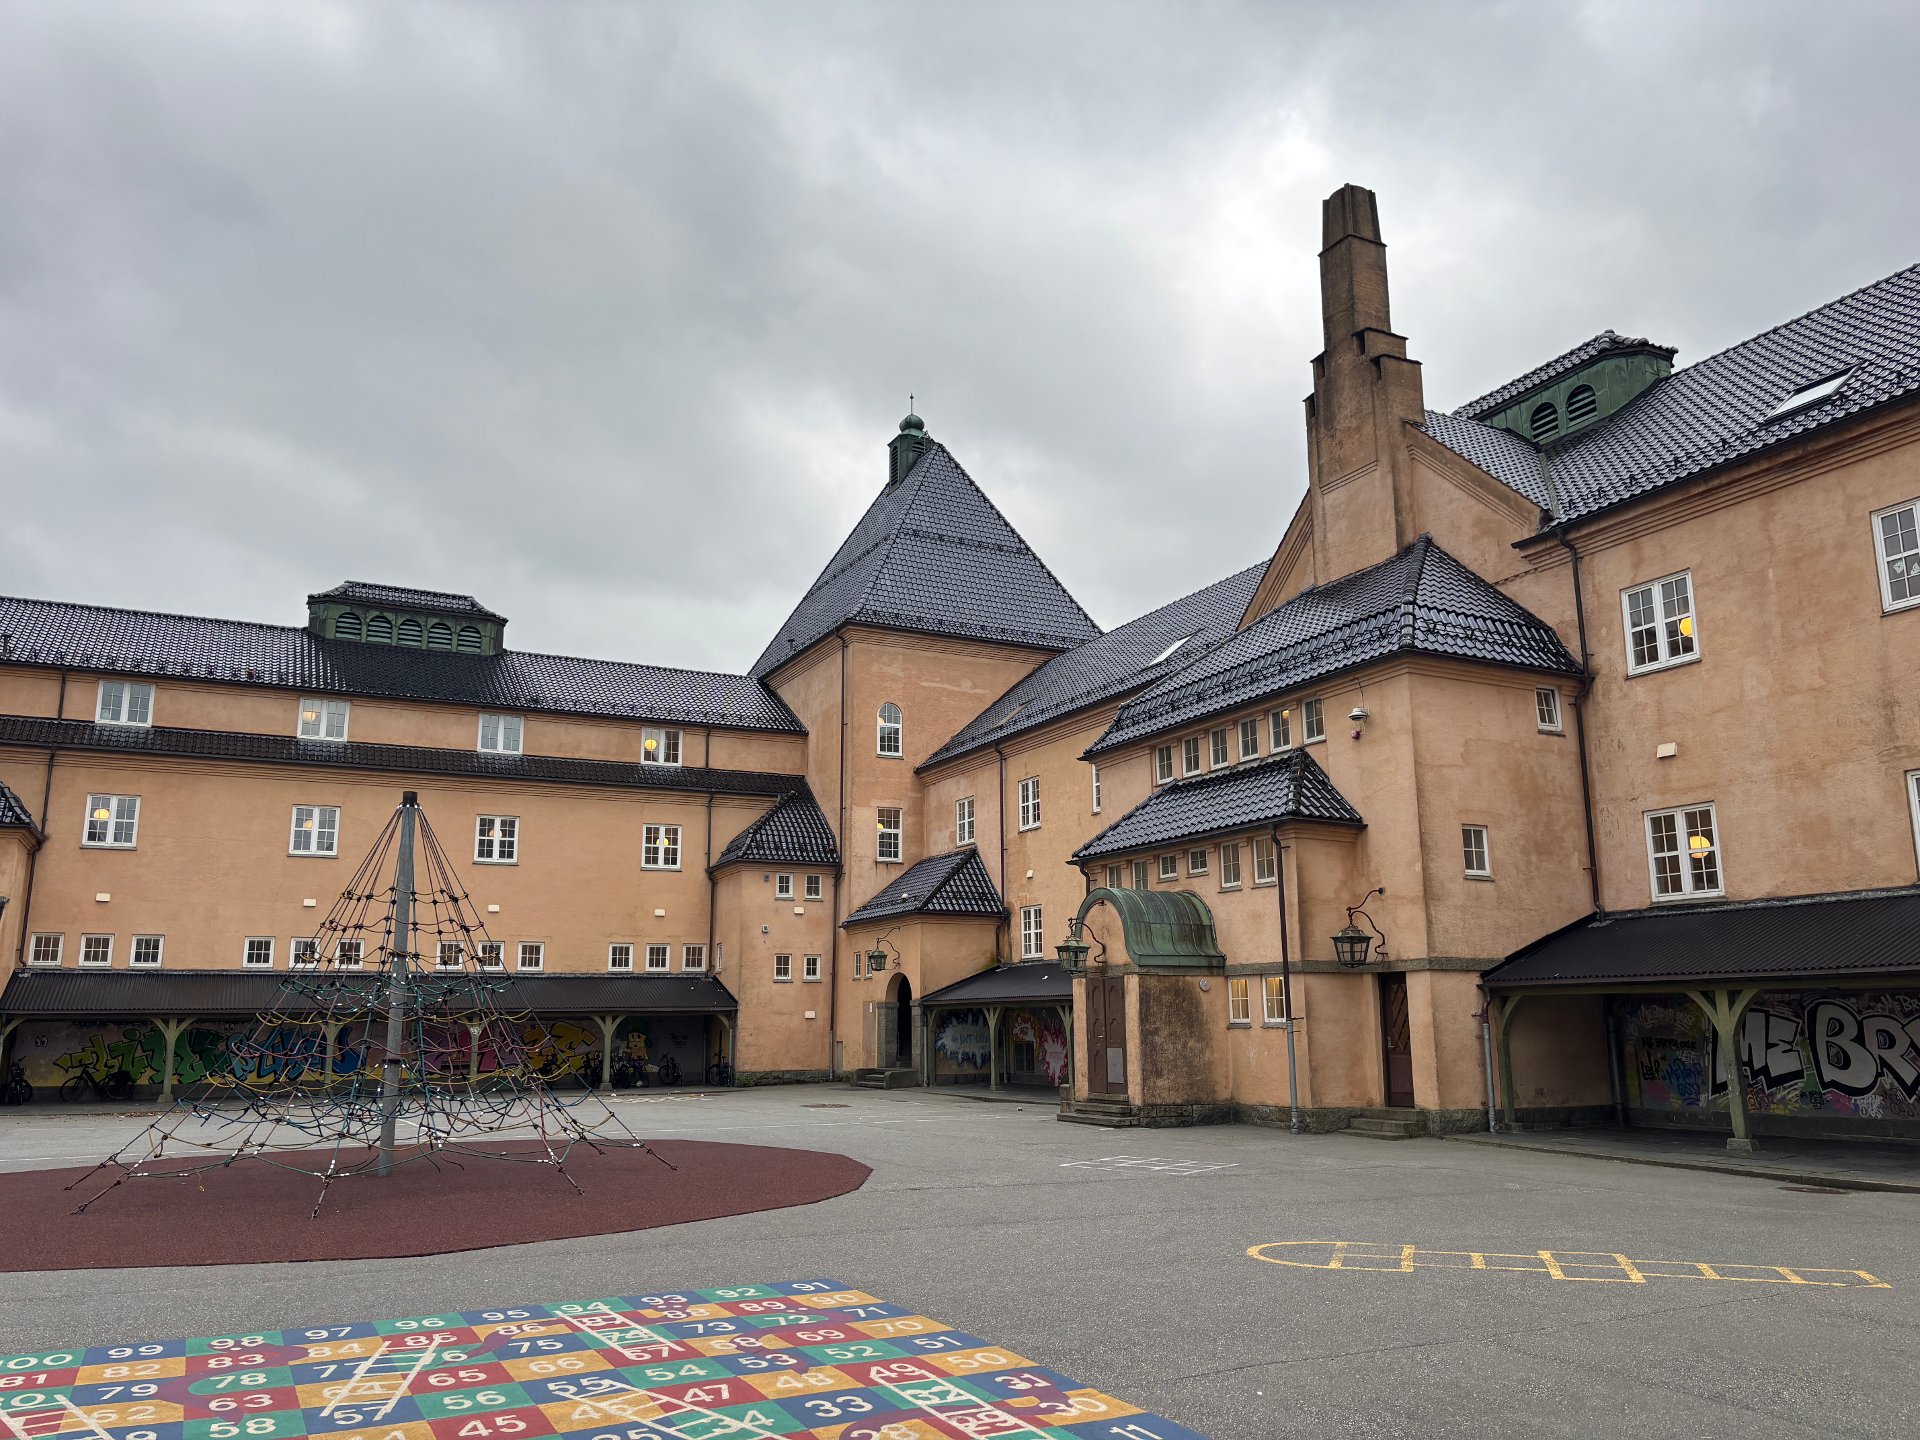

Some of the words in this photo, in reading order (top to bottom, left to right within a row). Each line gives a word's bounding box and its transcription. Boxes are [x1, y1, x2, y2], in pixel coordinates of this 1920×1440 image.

[1806, 1000, 1920, 1103] BR
[0, 1353, 74, 1370] 00
[107, 1345, 164, 1359] 99
[211, 1335, 265, 1350] 98
[304, 1327, 352, 1340] 97
[395, 1318, 445, 1330] 96
[481, 1310, 530, 1321] 95
[560, 1301, 612, 1313] 94
[641, 1294, 688, 1305] 93
[716, 1287, 763, 1299] 92
[791, 1282, 831, 1292] 91
[0, 1374, 48, 1388] 81
[103, 1364, 161, 1378] 82
[207, 1353, 266, 1369] 83
[307, 1343, 366, 1358] 84
[404, 1332, 458, 1346] 85
[497, 1323, 545, 1336] 86
[665, 1306, 710, 1319] 88
[738, 1301, 786, 1313] 89
[811, 1294, 856, 1305] 90
[0, 1393, 46, 1407] 0
[97, 1383, 159, 1400] 79
[209, 1372, 268, 1389] 78
[507, 1339, 564, 1354] 75
[682, 1322, 736, 1334] 73
[764, 1314, 811, 1326] 72
[843, 1307, 889, 1318] 71
[89, 1405, 156, 1423] 62
[208, 1394, 274, 1412] 63
[428, 1368, 488, 1387] 65
[528, 1358, 585, 1373] 66
[624, 1346, 669, 1361] 67
[709, 1337, 763, 1350] 68
[796, 1329, 846, 1342] 69
[871, 1320, 924, 1333] 70
[208, 1417, 276, 1438] 58
[334, 1404, 386, 1425] 57
[442, 1391, 507, 1410] 56
[546, 1376, 612, 1396] 55
[644, 1364, 708, 1381] 54
[738, 1353, 798, 1369] 53
[823, 1346, 883, 1360] 52
[912, 1336, 963, 1349] 51
[458, 1414, 527, 1438] 45
[683, 1384, 730, 1403] 47
[776, 1372, 835, 1389] 48
[869, 1362, 924, 1380] 49
[946, 1352, 1008, 1368] 50
[804, 1395, 874, 1418] 33
[995, 1373, 1052, 1390] 31
[1039, 1397, 1108, 1417] 30
[1109, 1424, 1163, 1440] 11
